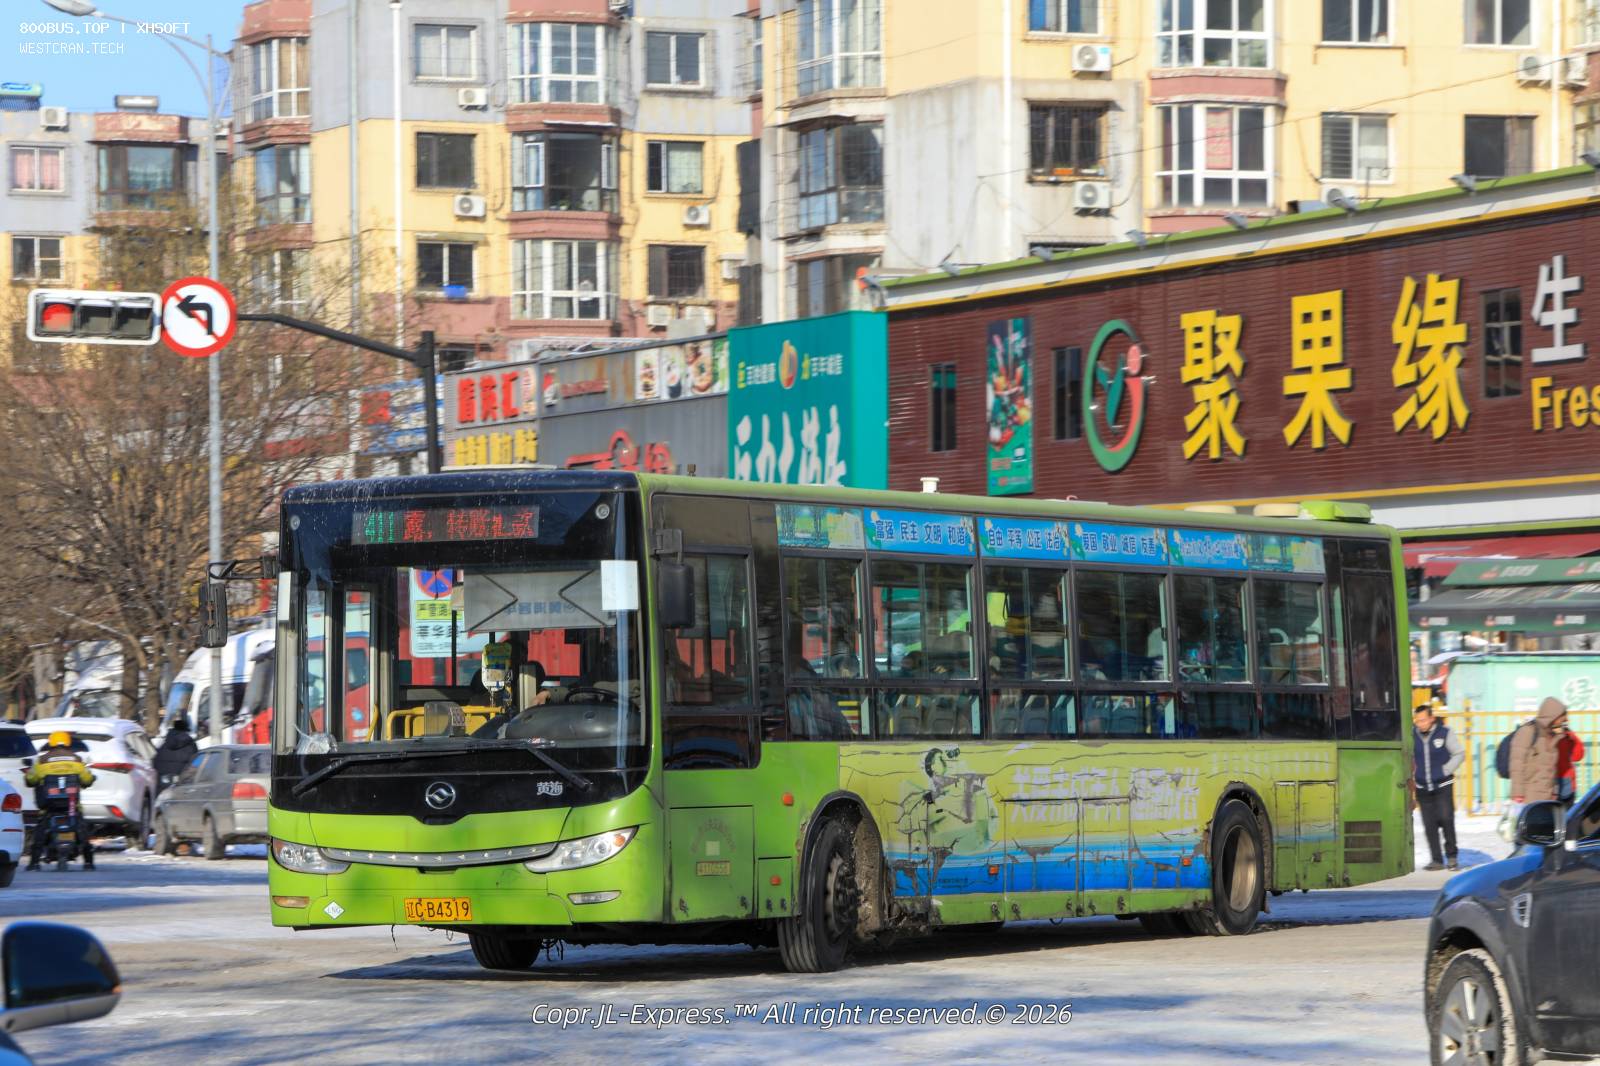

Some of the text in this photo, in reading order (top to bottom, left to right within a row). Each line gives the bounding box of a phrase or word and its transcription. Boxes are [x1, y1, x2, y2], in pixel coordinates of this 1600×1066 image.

[1180, 254, 1585, 462] 聚果缘 生
[875, 519, 894, 540] 富强
[900, 521, 918, 541] 民主
[924, 523, 942, 544] 文明
[948, 525, 966, 545] 和谐
[987, 528, 1062, 551] 自由 平等 公正 法治
[1082, 532, 1155, 556] 爱国 敬业 诚信 友善
